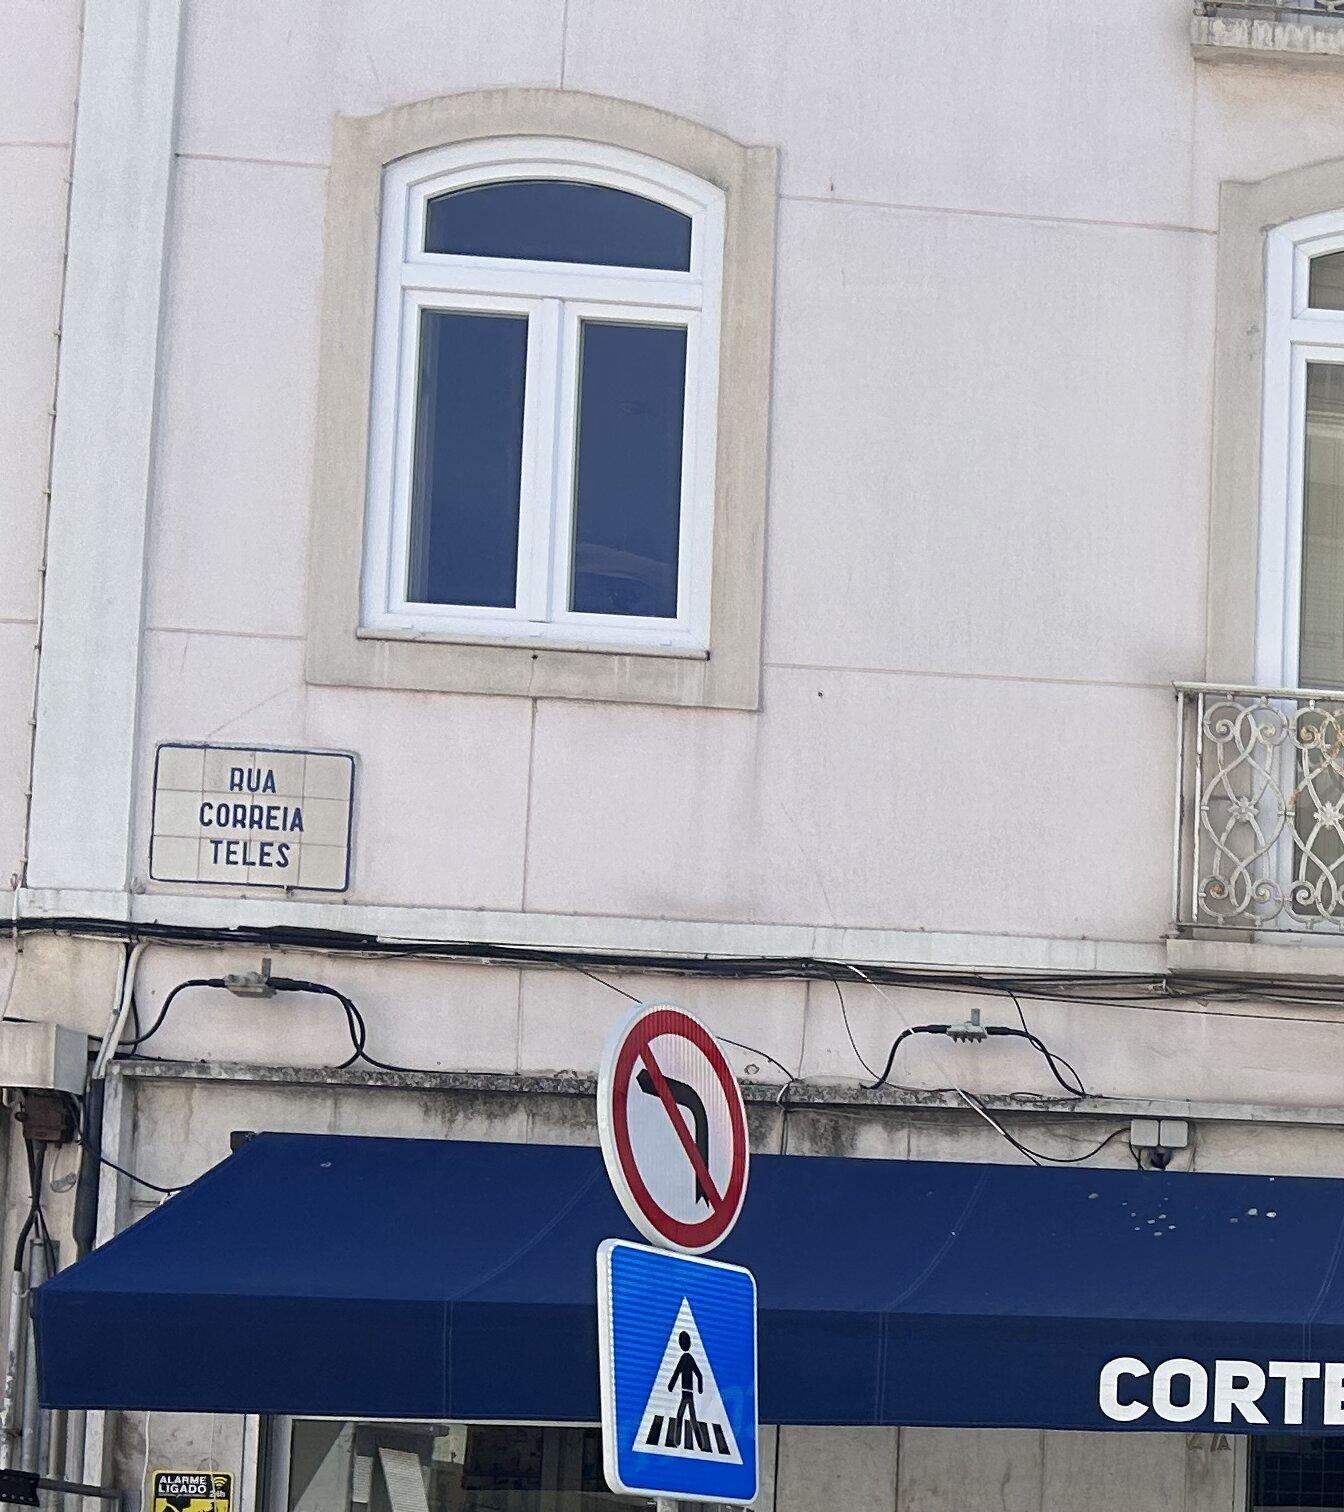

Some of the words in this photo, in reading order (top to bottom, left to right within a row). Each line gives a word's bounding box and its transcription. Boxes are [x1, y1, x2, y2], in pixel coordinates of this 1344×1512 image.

[229, 767, 277, 794] RUA
[199, 801, 304, 832] CORREIA
[209, 839, 291, 868] TELES
[158, 1484, 207, 1493] LIGADO
[159, 1475, 207, 1485] ALARME
